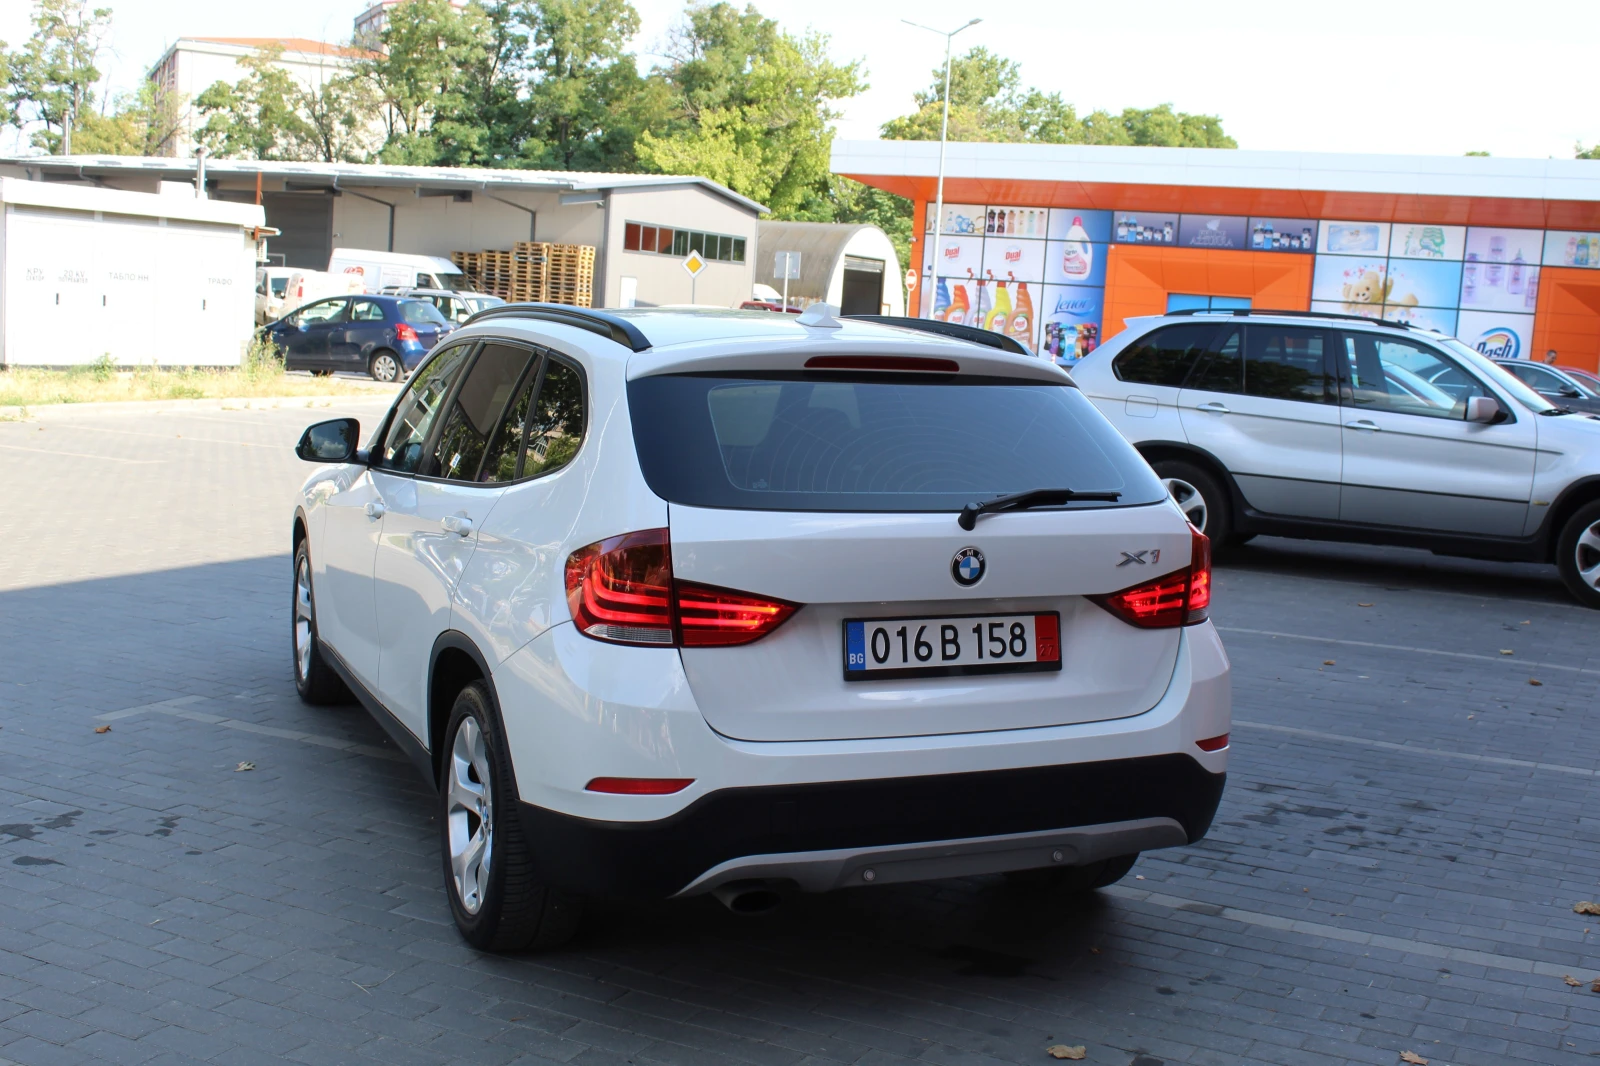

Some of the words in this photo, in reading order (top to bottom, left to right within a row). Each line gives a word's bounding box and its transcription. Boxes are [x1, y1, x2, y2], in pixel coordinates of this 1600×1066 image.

[945, 247, 960, 257] Dual
[1005, 250, 1021, 260] Dual
[109, 272, 135, 281] ТАБЛО
[1054, 294, 1092, 314] Lenor
[956, 549, 984, 562] BMW
[1116, 549, 1160, 566] X1
[870, 624, 932, 664] 016
[941, 624, 961, 660] B
[972, 621, 1028, 660] 158
[1039, 644, 1054, 657] 27
[849, 652, 864, 665] BG
